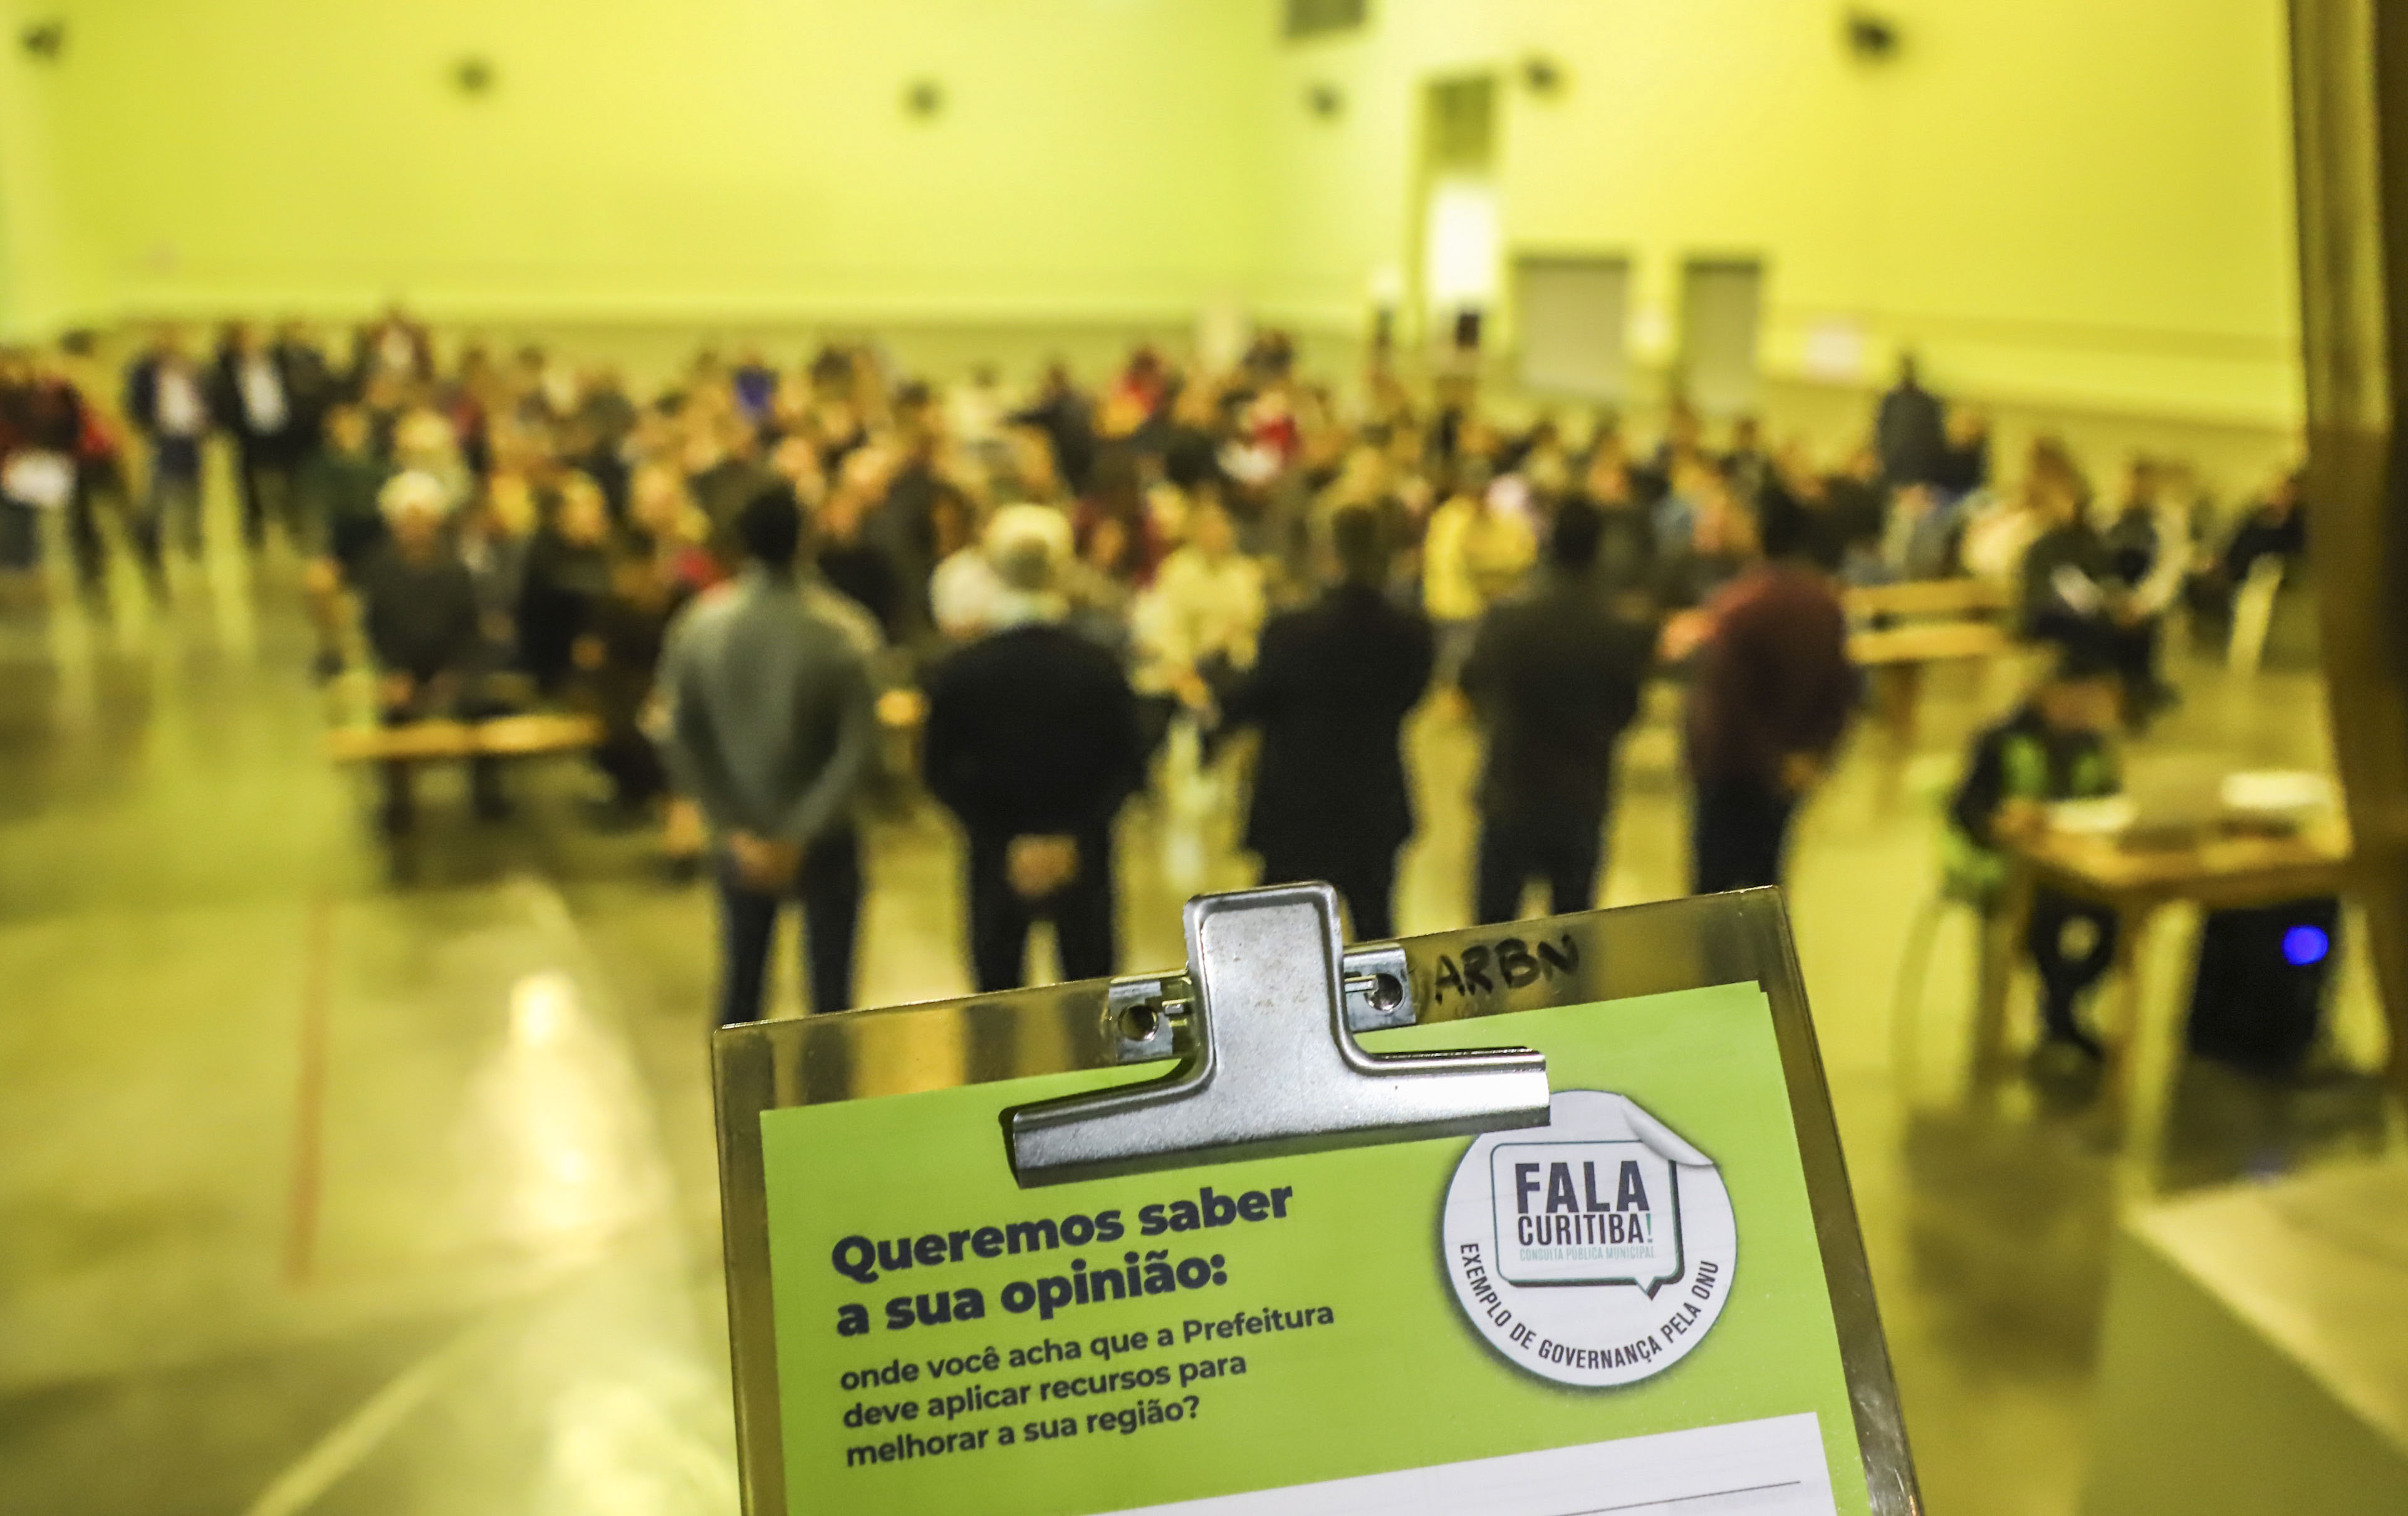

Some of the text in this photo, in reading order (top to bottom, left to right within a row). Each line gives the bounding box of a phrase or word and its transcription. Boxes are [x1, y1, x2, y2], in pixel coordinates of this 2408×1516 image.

[1515, 1160, 1650, 1213] FALA
[831, 1185, 1293, 1284] Queremos saber
[1518, 1213, 1653, 1245] CURITIBA!
[1519, 1247, 1563, 1262] CONSULTA
[1606, 1245, 1655, 1259] MUNICIPAL
[836, 1250, 1227, 1336] a sua opinião:
[1461, 1242, 1719, 1369] EXEMPLO DE GOVERNANÇA PELA ONU
[840, 1301, 1335, 1391] onde você acha que a Prefeitura
[843, 1354, 1246, 1429] deve aplicar recursos para
[847, 1395, 1200, 1468] melhorar a sua região?
